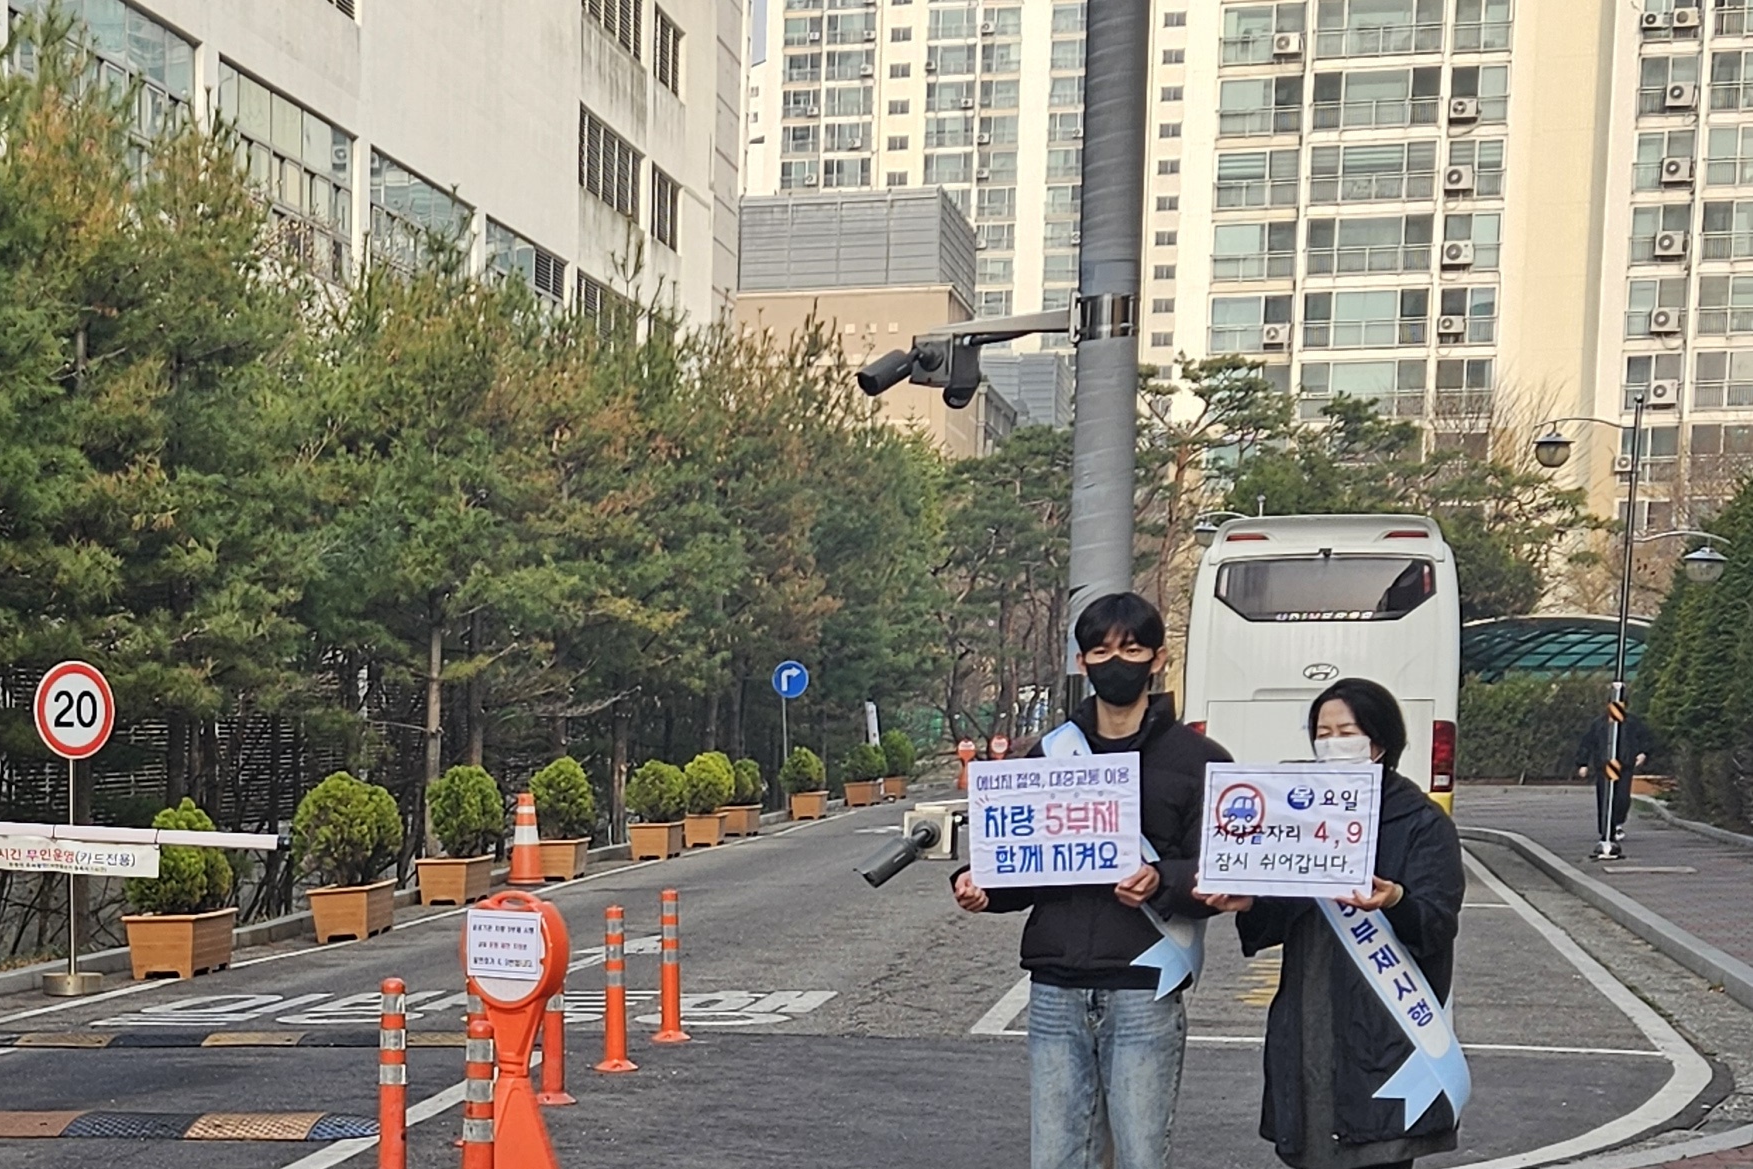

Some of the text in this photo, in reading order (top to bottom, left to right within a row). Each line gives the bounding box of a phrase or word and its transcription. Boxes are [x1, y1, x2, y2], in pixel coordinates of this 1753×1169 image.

[54, 690, 97, 728] 20
[976, 767, 1129, 791] 에너지 절약, 대중교통 이용
[984, 800, 1120, 838] 차량 5부제
[996, 841, 1118, 875] 함께 지켜요
[1215, 852, 1354, 875] 잠시 쉬어갑니다.
